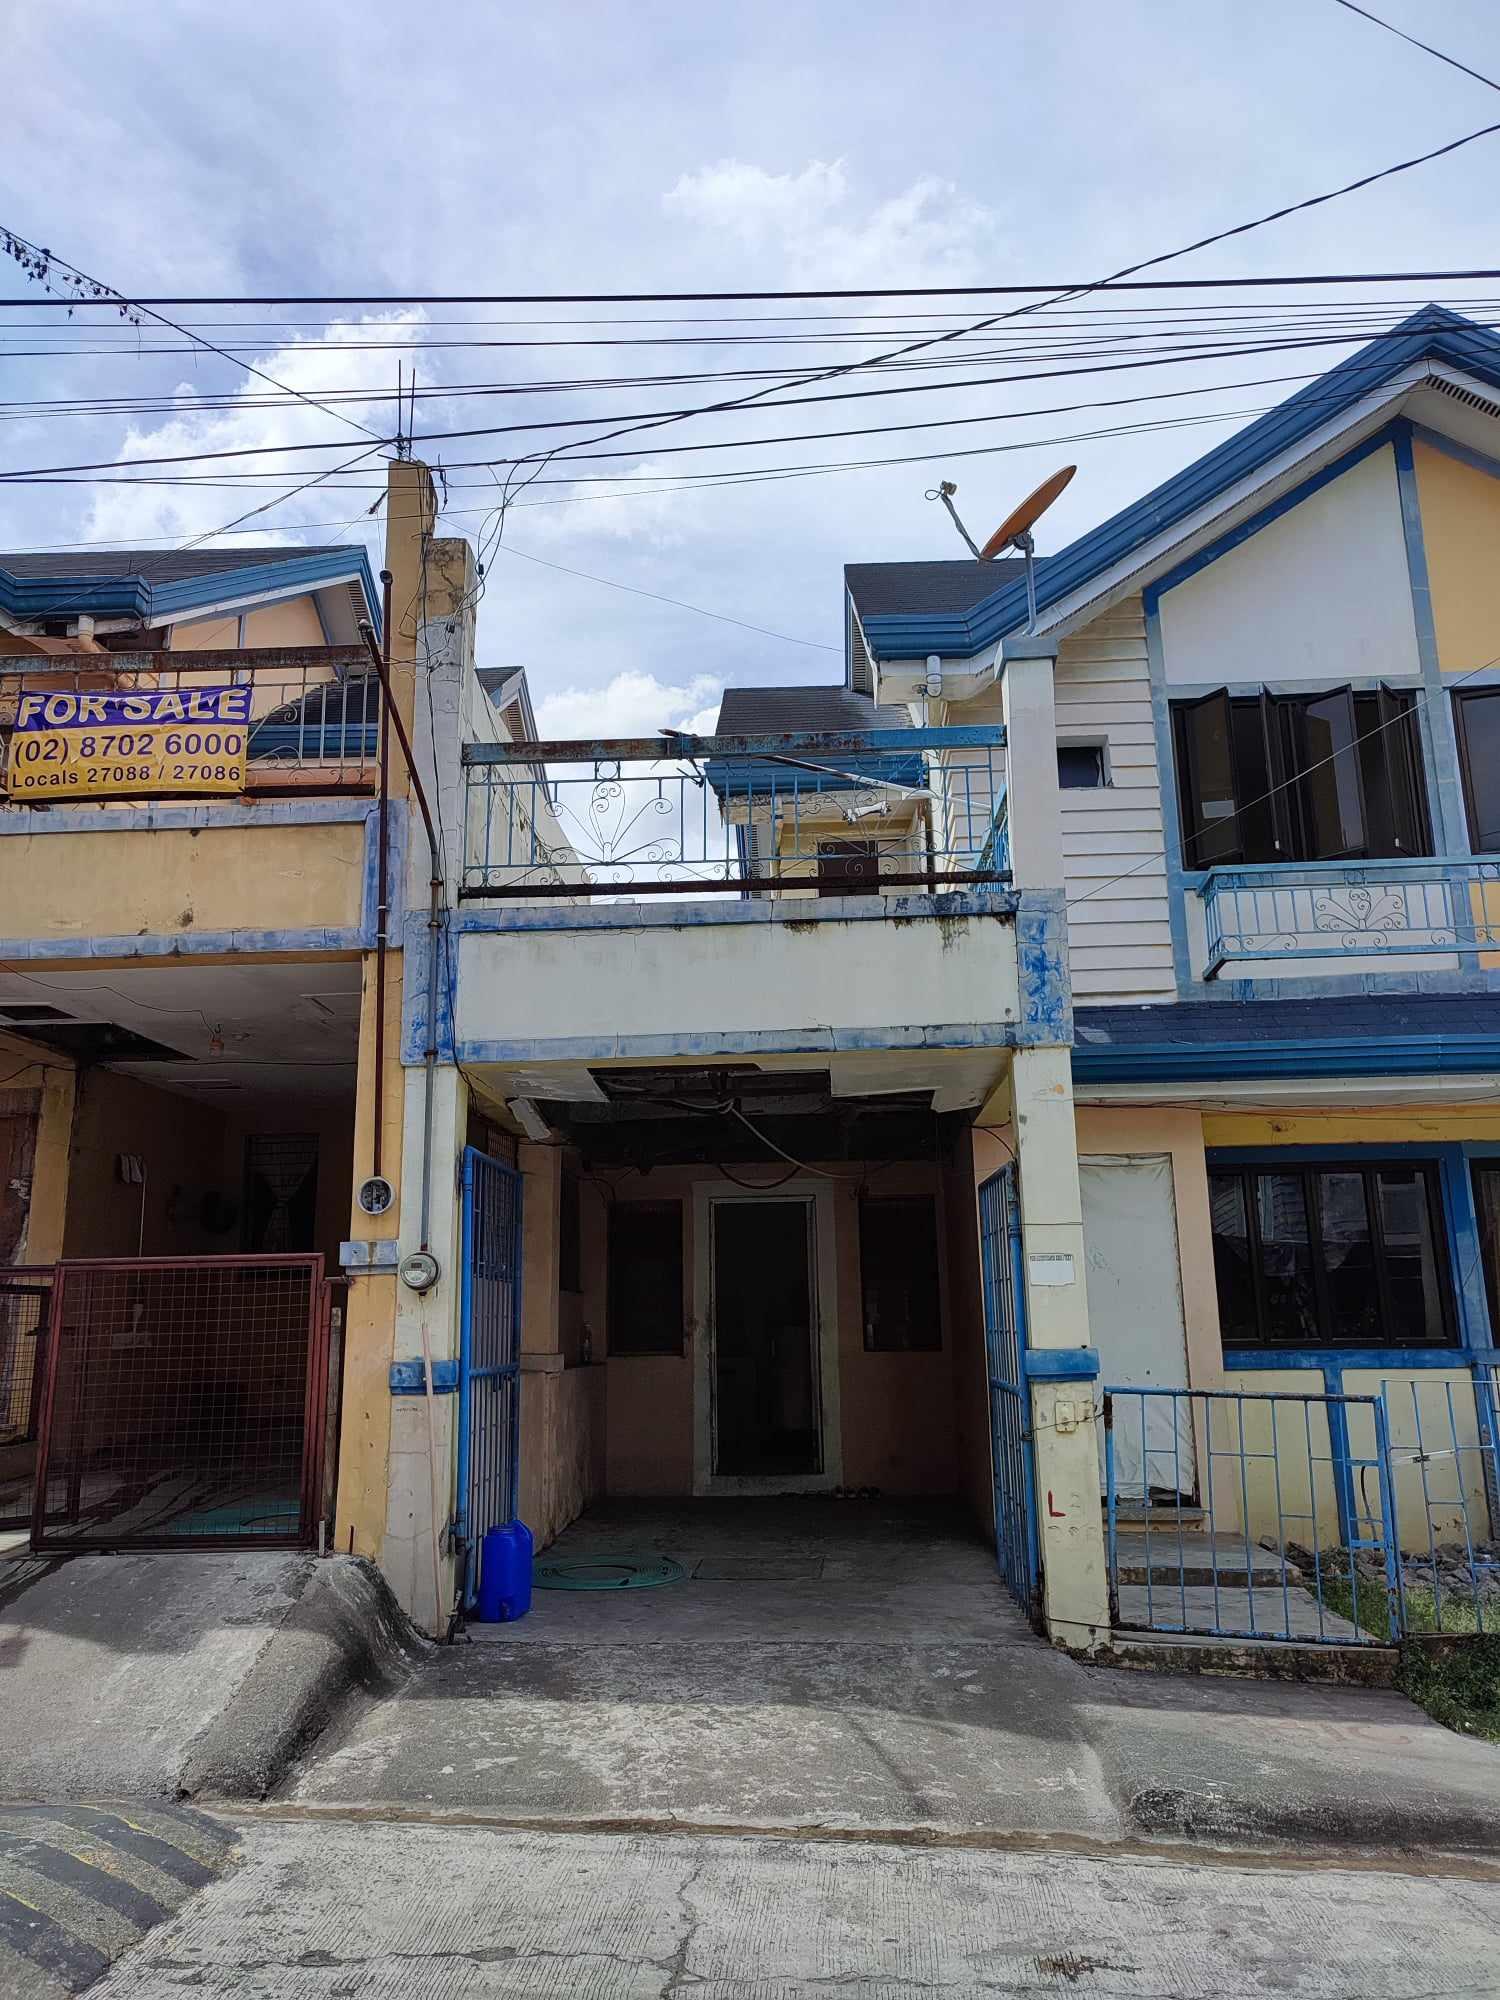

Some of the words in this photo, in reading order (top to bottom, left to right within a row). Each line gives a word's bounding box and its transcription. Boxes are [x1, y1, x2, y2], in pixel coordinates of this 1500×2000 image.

[18, 695, 107, 727] FOR
[123, 689, 248, 720] SALE
[15, 738, 69, 768] (02)
[80, 734, 153, 757] 8702
[165, 734, 241, 756] 6000
[12, 771, 78, 788] Locals
[87, 766, 150, 782] 27088
[158, 765, 164, 780] /
[173, 765, 240, 780] 27086
